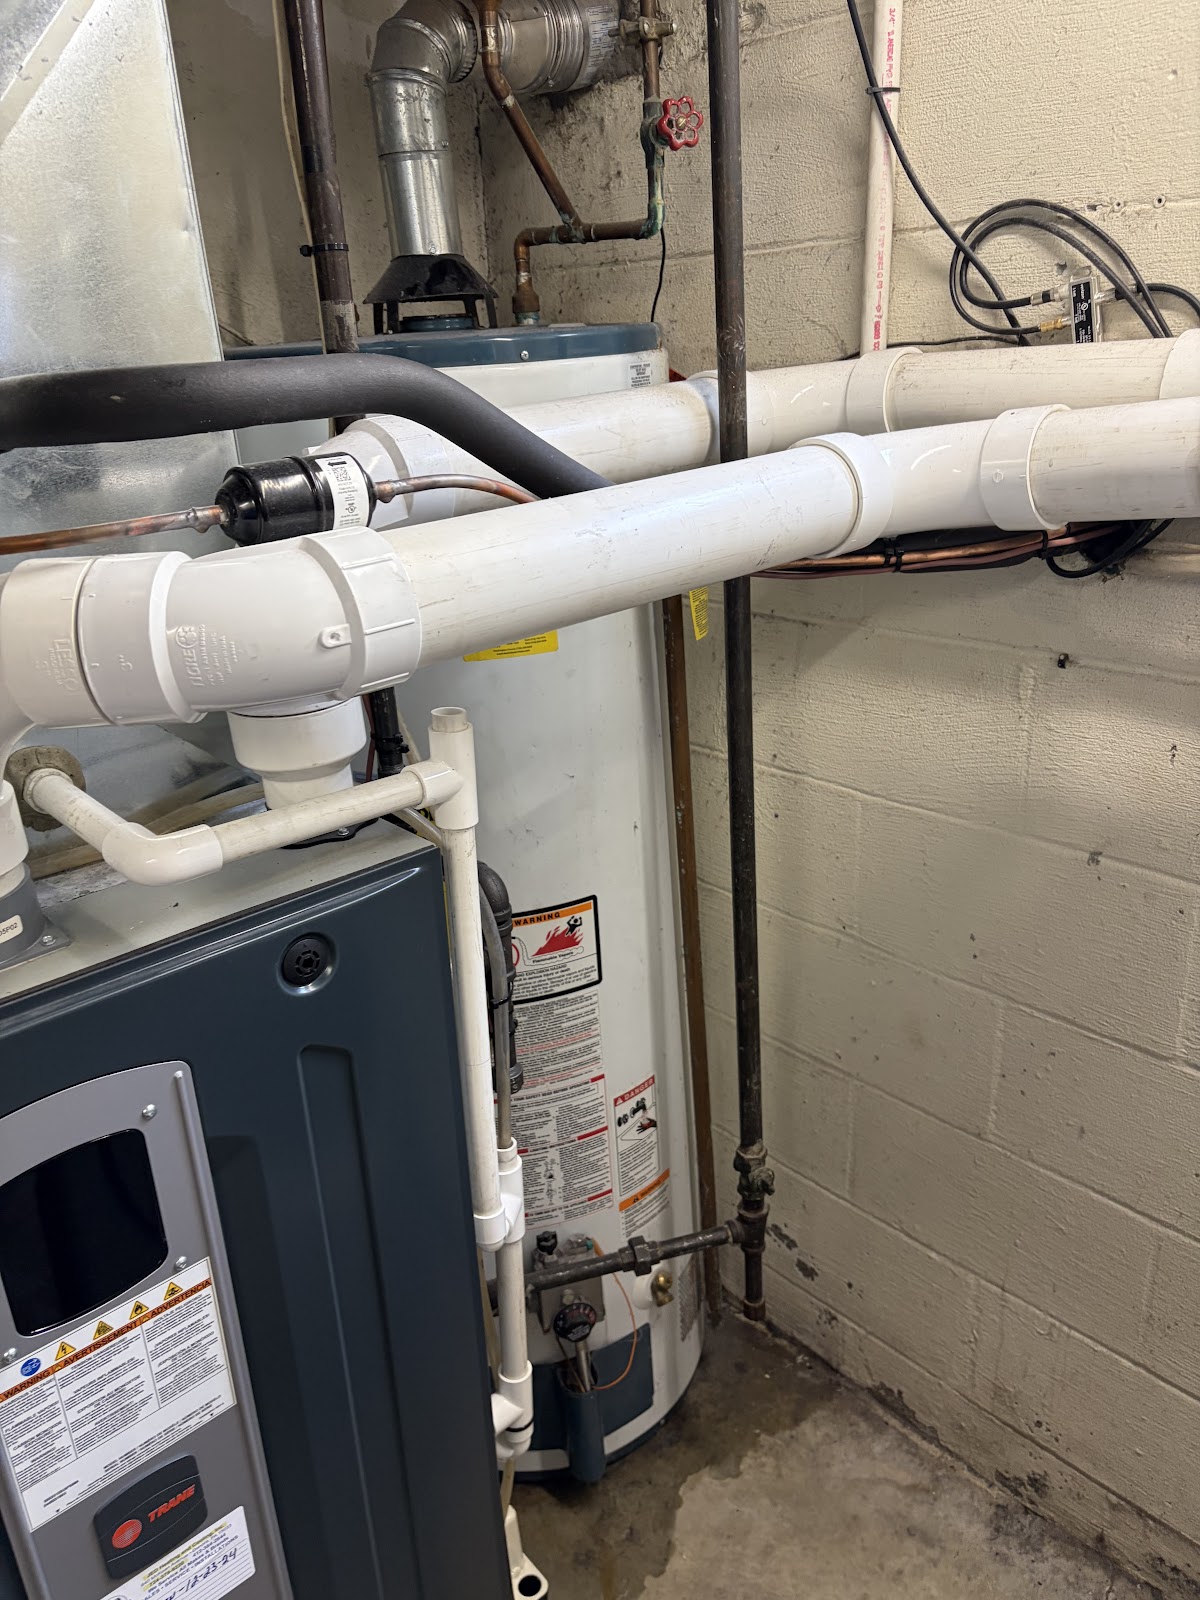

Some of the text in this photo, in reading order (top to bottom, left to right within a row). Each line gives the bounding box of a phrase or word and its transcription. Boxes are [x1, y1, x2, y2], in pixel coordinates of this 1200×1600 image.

[186, 648, 204, 687] TIGRE
[514, 912, 560, 926] WARNING
[624, 1078, 654, 1100] DANGER
[151, 1280, 211, 1316] ADVERTENCIA
[64, 1322, 138, 1365] AVERTISSEMENT
[4, 1371, 50, 1399] WARNING
[148, 1484, 196, 1523] TRANE
[158, 1570, 177, 1586] Service
[187, 1552, 203, 1565] Makes
[210, 1536, 228, 1550] Brands
[159, 1553, 179, 1569] Heating
[180, 1545, 191, 1555] and
[164, 1567, 190, 1587] SERVICE
[194, 1534, 238, 1567] INSTALLATIONS
